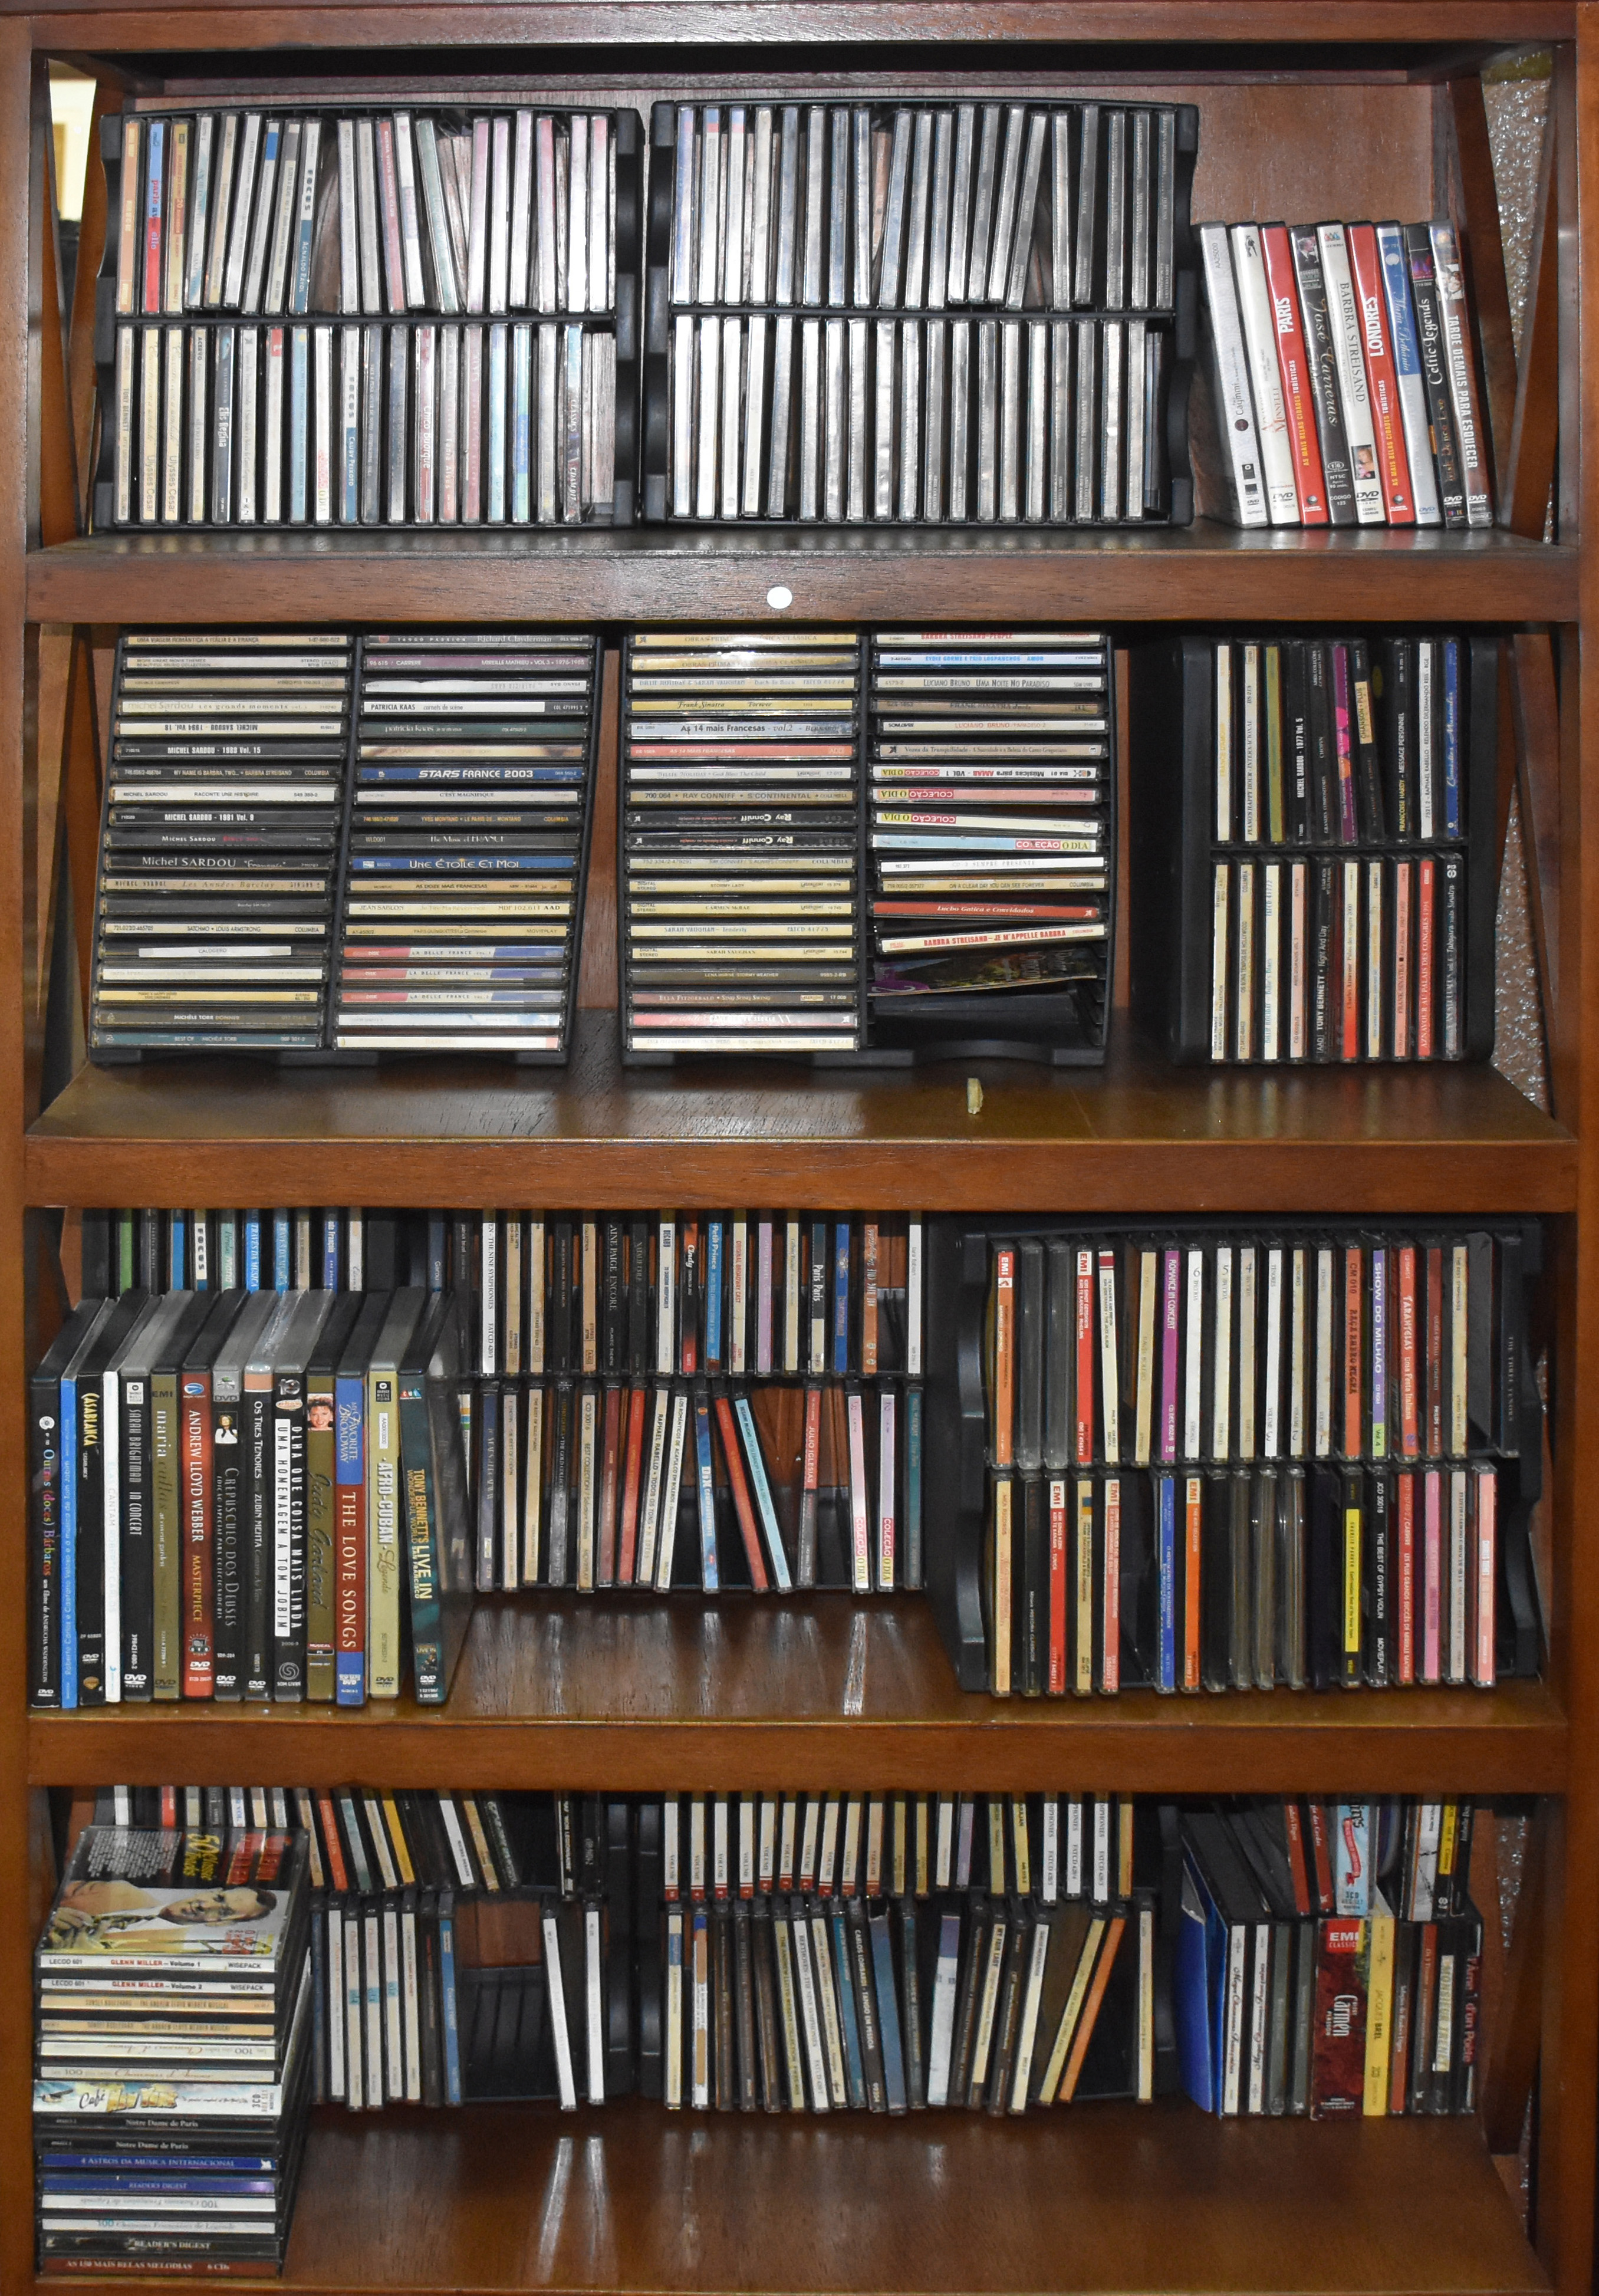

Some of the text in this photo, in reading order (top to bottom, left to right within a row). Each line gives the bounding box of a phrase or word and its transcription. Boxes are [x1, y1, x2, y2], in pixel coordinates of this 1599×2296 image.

[1278, 297, 1294, 333] PARIS
[1367, 297, 1384, 357] LONDRES
[1340, 283, 1355, 330] BARBRA
[1348, 335, 1366, 402] STREISAND
[1421, 299, 1443, 385] Celtic Legends
[1307, 299, 1338, 426] José Carreras
[1232, 383, 1244, 416] Caymmi
[1449, 315, 1478, 468] TARDE DEMAIS PARA ESQUECER
[217, 407, 229, 447] Elis Regina
[421, 406, 432, 468] Chico Buarque
[1356, 491, 1378, 500] DVD
[1444, 495, 1462, 504] DVD
[1469, 495, 1486, 504] DVD
[419, 769, 532, 778] STARS FRANCE 2003
[909, 790, 953, 799] COLEÇÃO
[742, 814, 771, 822] Conniff
[912, 814, 955, 824] COLEÇÃO
[742, 836, 772, 844] Conniff
[142, 857, 236, 867] Michel SARDOU
[1319, 926, 1328, 938] Day
[686, 1245, 695, 1267] Cindy
[813, 1265, 824, 1301] Paris Paris
[1167, 1300, 1176, 1329] CONCERT
[1403, 1296, 1413, 1350] TARANTELAS
[1404, 1373, 1413, 1391] Festa
[83, 1393, 99, 1446] CASABLANCA
[129, 1409, 142, 1432] SARAH
[338, 1404, 350, 1463] BROADWAY
[277, 1427, 288, 1450] UMA
[129, 1437, 142, 1483] BRIGHTMAN
[253, 1402, 262, 1548] OS TRES TENORES ZUBIN MEHTA
[277, 1460, 288, 1535] HOMENAGEM
[377, 1463, 393, 1544] AFRO-CUBAN
[407, 1469, 416, 1514] WONDERFUL
[414, 1469, 429, 1543] TONY BENNETT'S
[129, 1504, 142, 1535] CONCERT
[189, 1411, 204, 1622] ANDREW LLOYD WEBBER MASTERPIECE
[290, 1426, 302, 1628] OLHA QUE COISA MAIS LINDA
[307, 1472, 333, 1610] Judy Garland
[856, 1518, 865, 1555] COLEÇÃO
[883, 1518, 891, 1556] COLEÇÃO
[277, 1559, 288, 1581] TOM
[342, 1492, 356, 1649] THE LOVE SONGS
[417, 1545, 432, 1599] LIVE IN
[857, 1565, 866, 1580] DIA
[1377, 1565, 1383, 1573] OF
[277, 1590, 288, 1628] JOBIM
[190, 1662, 210, 1670] DVD
[854, 1929, 863, 1952] CARLOS
[1330, 1932, 1359, 1941] EMI
[857, 1955, 866, 1986] LOMBARDI
[864, 2015, 871, 2024] EM
[1374, 1990, 1383, 2021] JACQUES
[866, 2026, 874, 2049] PESSOA
[80, 2093, 106, 2108] Café
